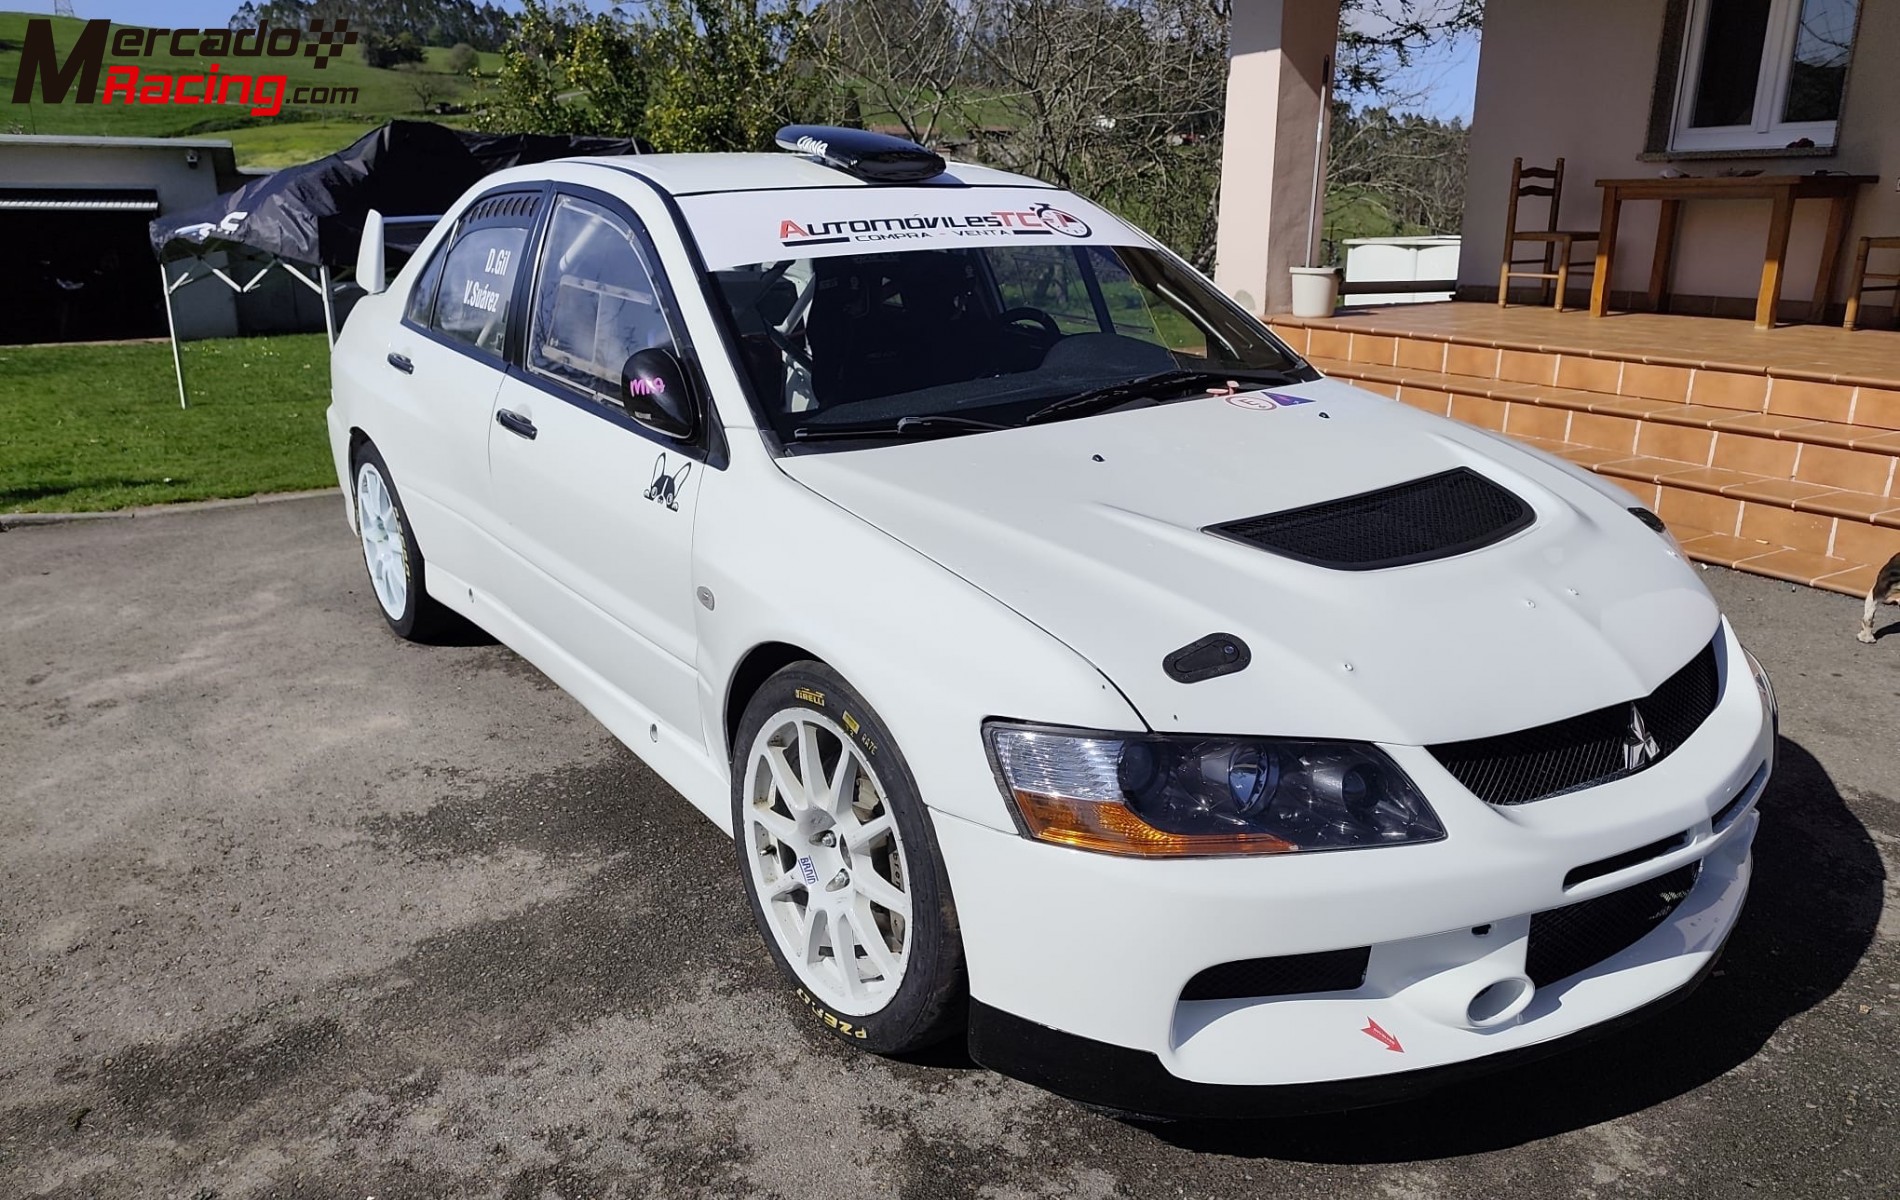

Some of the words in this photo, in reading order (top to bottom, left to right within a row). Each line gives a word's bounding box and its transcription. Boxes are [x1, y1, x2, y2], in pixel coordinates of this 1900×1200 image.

[855, 231, 933, 242] COMPRA
[954, 228, 1012, 236] VENTA
[484, 248, 511, 276] D.Gil
[463, 279, 500, 313] V.Suárez
